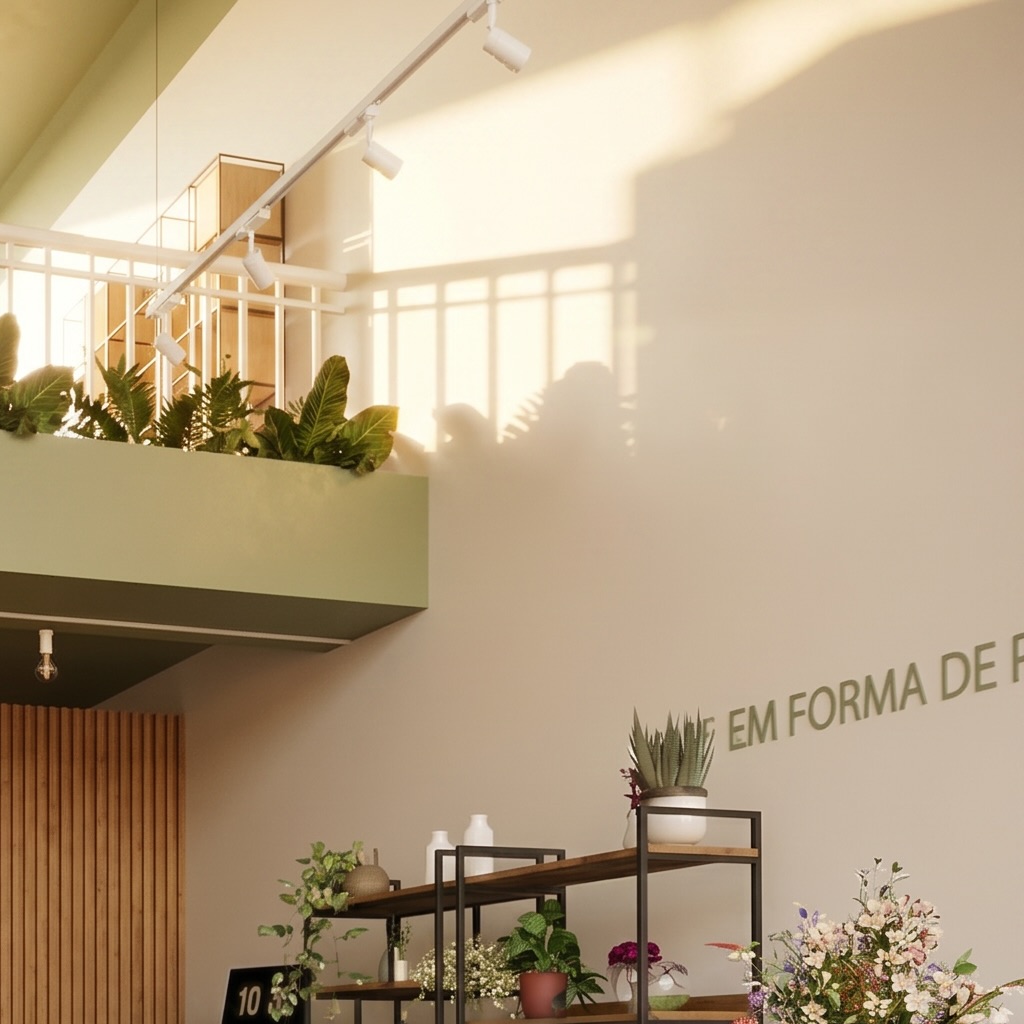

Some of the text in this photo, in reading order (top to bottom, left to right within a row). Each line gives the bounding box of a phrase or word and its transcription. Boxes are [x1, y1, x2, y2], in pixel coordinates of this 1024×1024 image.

[728, 699, 778, 752] EM
[789, 661, 928, 737] FORMA
[941, 640, 998, 701] DE
[238, 985, 262, 1017] 10
